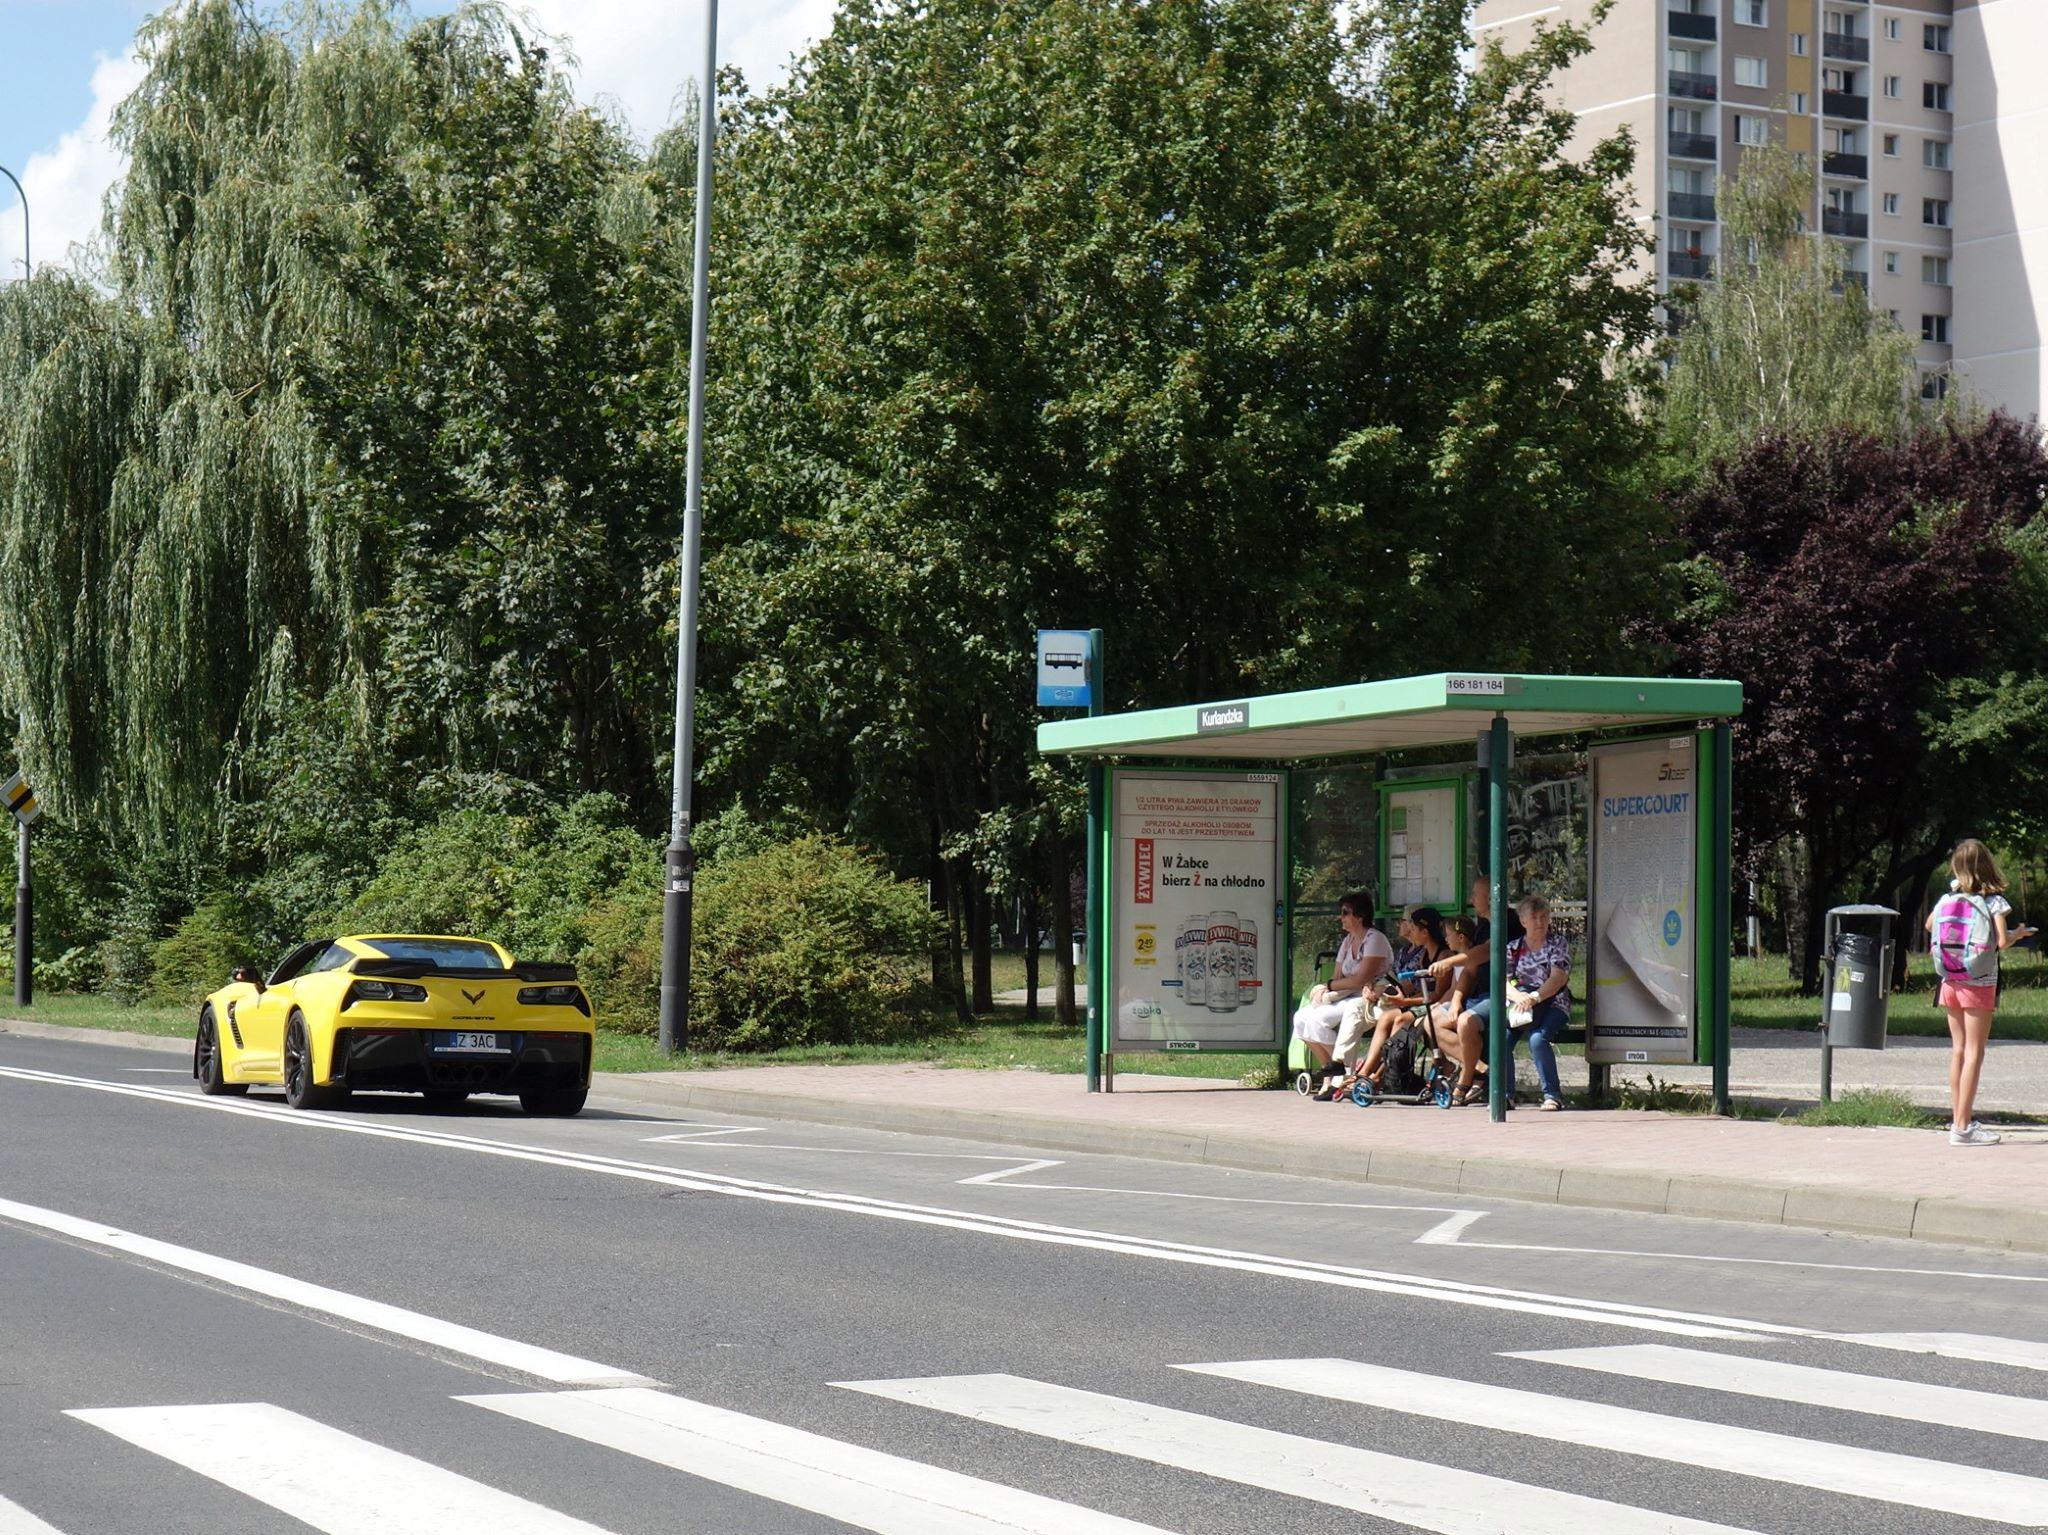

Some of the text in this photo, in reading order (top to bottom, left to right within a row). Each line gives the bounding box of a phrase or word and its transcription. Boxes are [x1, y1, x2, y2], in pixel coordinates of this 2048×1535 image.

[1448, 680, 1502, 690] 166 181 184
[1202, 709, 1243, 727] Kurlandzka
[1603, 793, 1689, 818] SUPERCOURT
[1162, 853, 1209, 869] W Żabce
[1137, 843, 1151, 899] ŻYWIEC
[1162, 871, 1266, 888] bierz Ż na chłodno
[458, 1035, 494, 1048] Z 3AC
